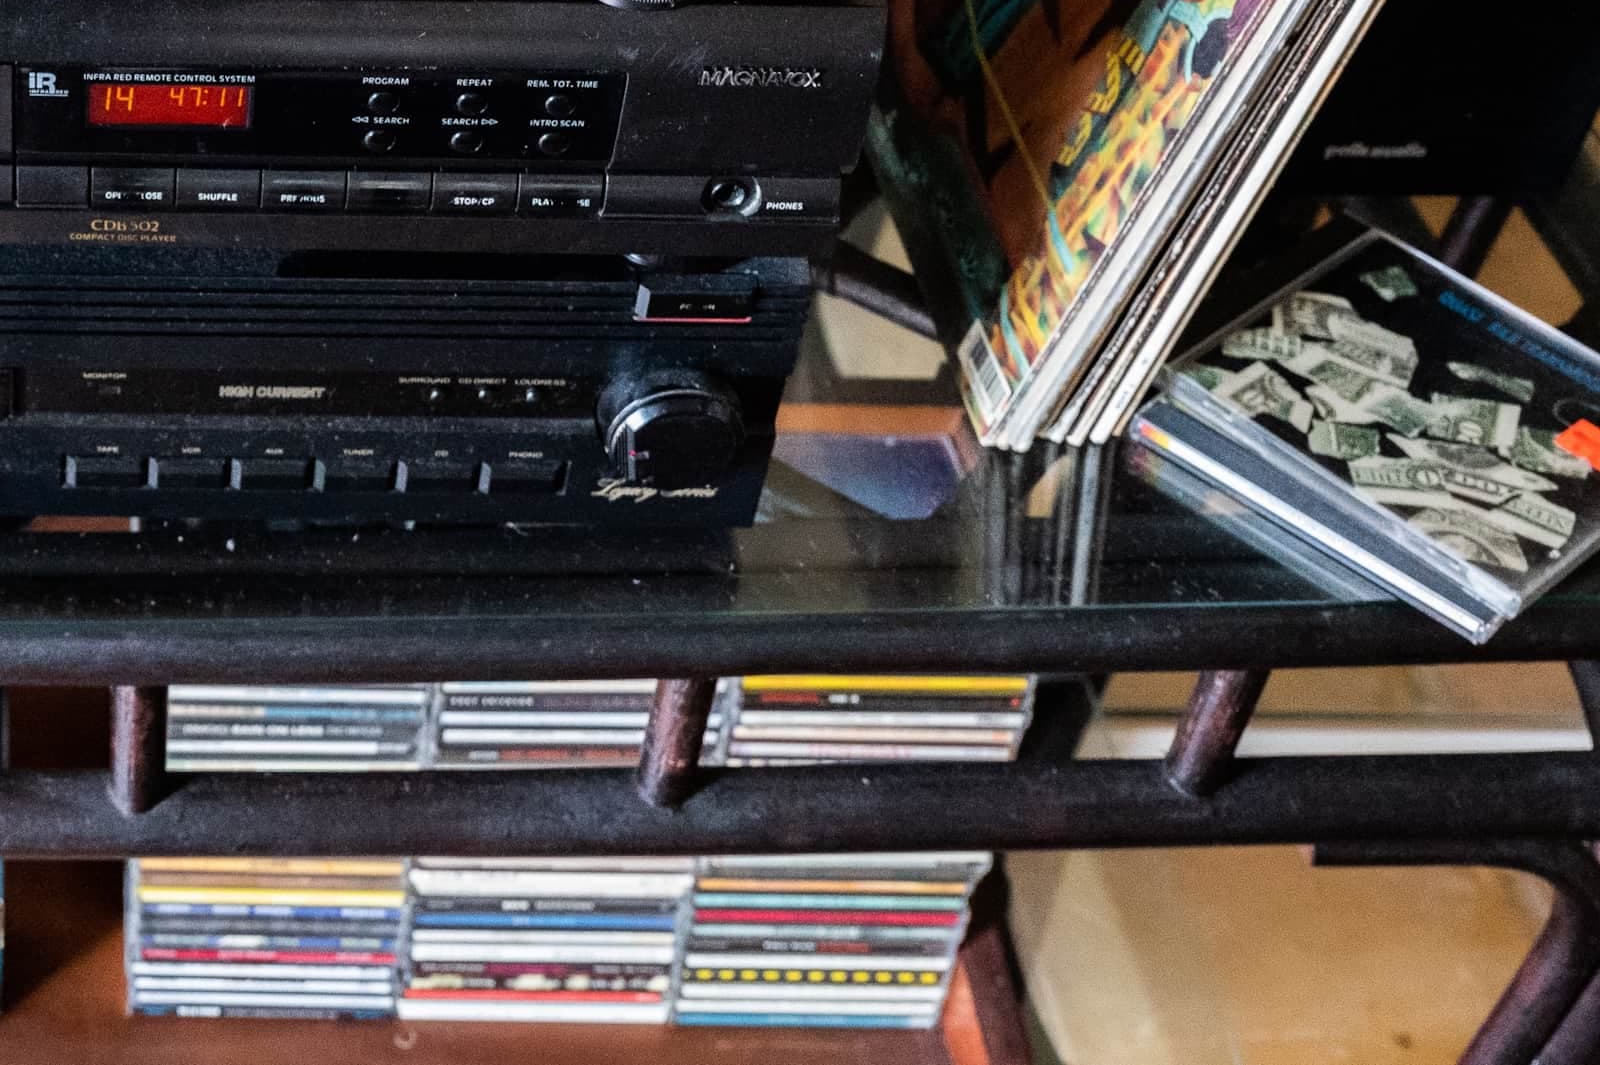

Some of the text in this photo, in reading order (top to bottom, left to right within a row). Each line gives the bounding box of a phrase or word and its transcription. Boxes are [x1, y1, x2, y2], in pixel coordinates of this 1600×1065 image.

[83, 73, 112, 81] INFRA
[134, 74, 172, 82] REMOTE
[174, 74, 217, 82] CONTROL
[219, 75, 256, 83] SYSTEM
[362, 77, 409, 86] PROGRAM
[700, 67, 821, 87] MAGNAVOX
[456, 79, 493, 87] REPEAT
[527, 80, 550, 88] REM.
[104, 87, 135, 112] 14
[373, 117, 410, 125] SEARCH
[441, 118, 478, 126] SEARCH
[529, 119, 558, 127] INTRO
[198, 193, 238, 202] SHUFFLE
[766, 201, 803, 211] PHONES
[69, 233, 115, 241] COMPACT
[140, 234, 177, 243] PLAYER
[218, 385, 326, 399] HIGH CURRENT
[508, 451, 543, 459] PHONO
